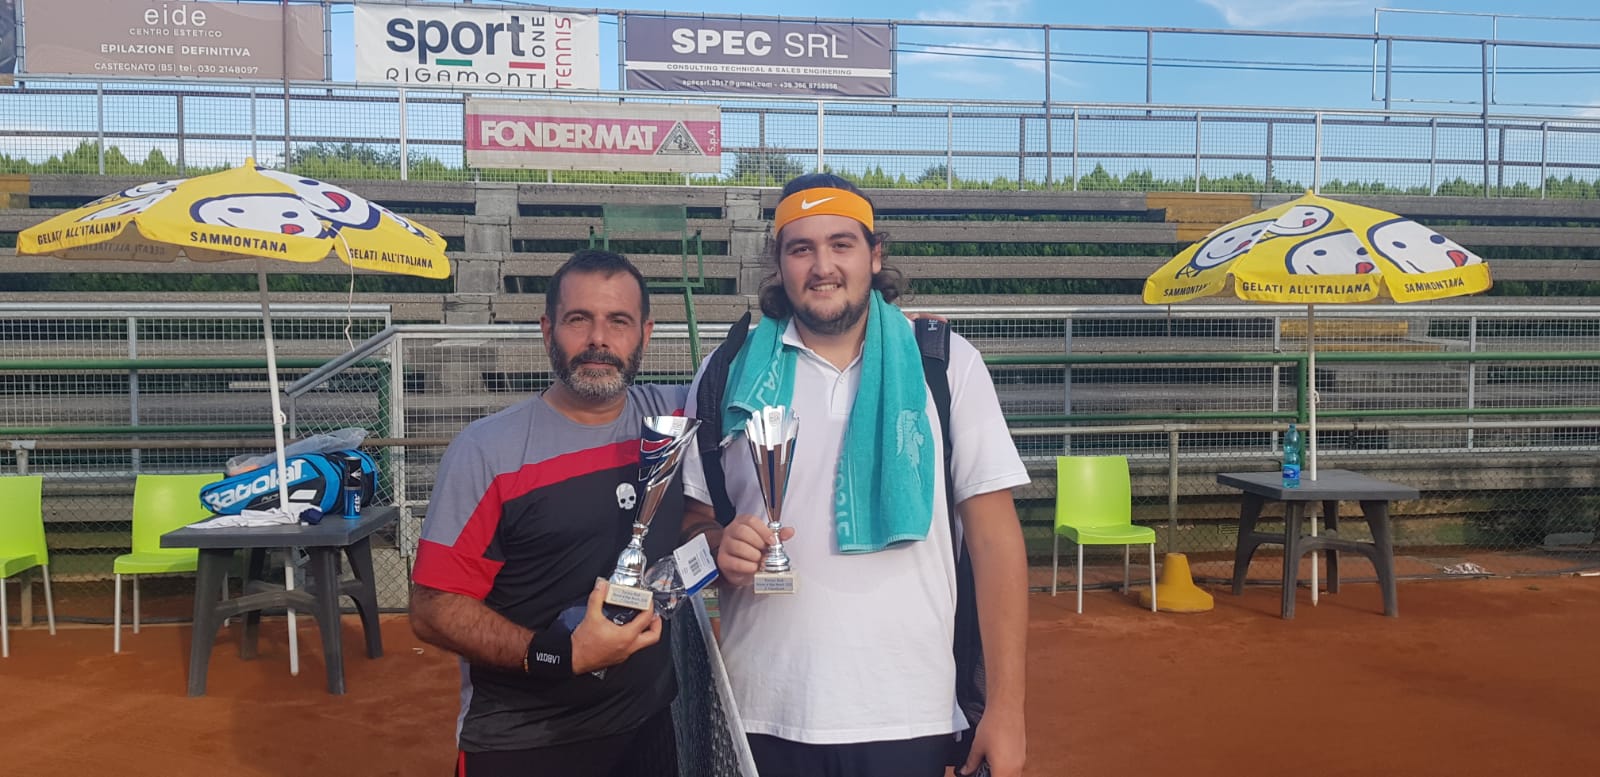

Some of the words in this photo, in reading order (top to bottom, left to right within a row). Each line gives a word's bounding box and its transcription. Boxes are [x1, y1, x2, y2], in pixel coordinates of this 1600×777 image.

[144, 4, 207, 27] eide
[129, 28, 170, 36] CENTRO
[173, 28, 223, 38] ESTETICO
[386, 16, 525, 65] sport
[532, 16, 546, 58] ONE
[101, 43, 174, 55] EPILAZIONE
[181, 46, 251, 57] DEFINITIVA
[671, 28, 772, 57] SPEC
[784, 32, 849, 59] SRL
[94, 62, 156, 72] CASTEGNATO
[179, 64, 196, 73] tel.
[198, 65, 216, 74] 030
[218, 65, 259, 74] 2148097
[667, 64, 718, 72] CONSULTING
[720, 65, 766, 73] TECHNICAL
[803, 68, 852, 76] ENGINERING
[480, 120, 658, 150] FONDERMAT
[37, 230, 63, 245] GELATI
[190, 231, 288, 254] SAMMONTANA
[349, 248, 378, 261] GELATI
[381, 251, 433, 269] ALL'ITALIANA
[1242, 281, 1284, 294] GELATI
[1288, 282, 1372, 295] ALL'ITALIANA
[1404, 276, 1465, 293] SAMMONTANA
